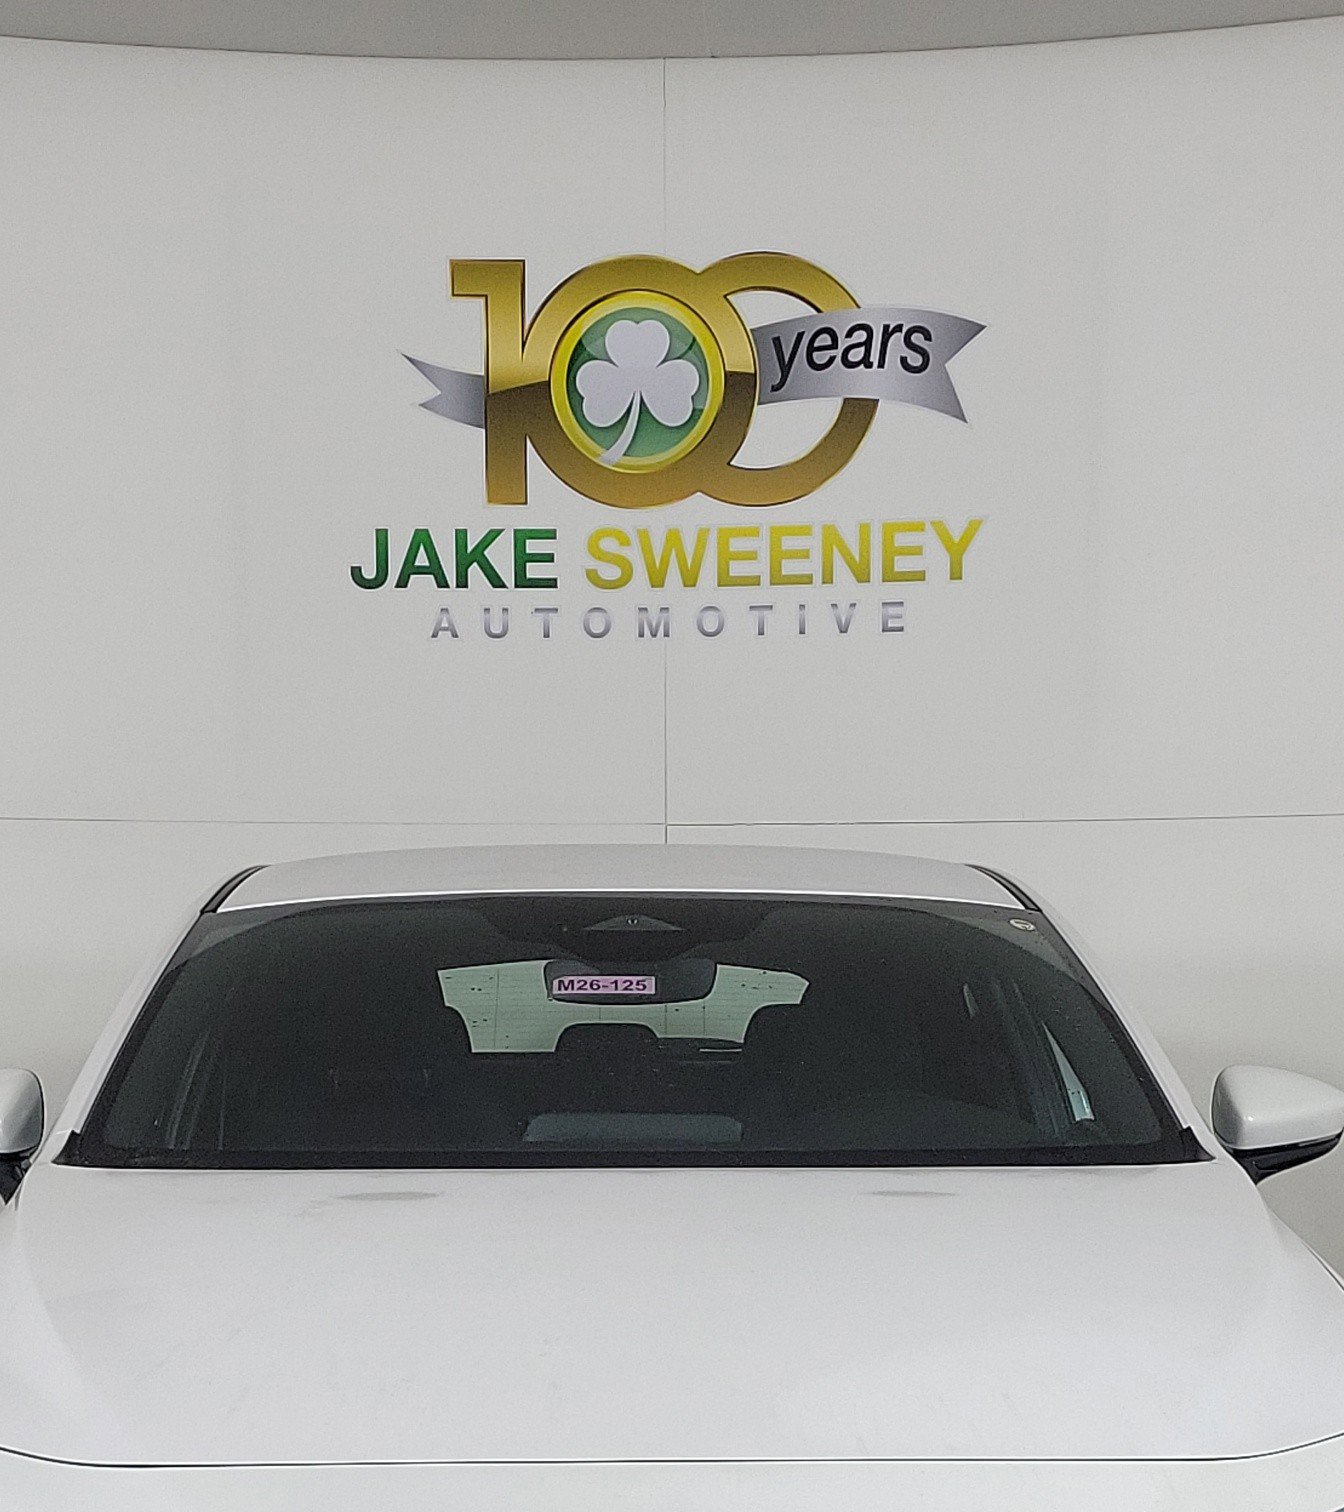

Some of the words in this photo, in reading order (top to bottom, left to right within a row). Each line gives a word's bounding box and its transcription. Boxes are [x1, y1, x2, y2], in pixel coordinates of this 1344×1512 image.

[449, 252, 879, 509] 100
[770, 321, 933, 393] years
[350, 527, 558, 590] JAKE
[585, 519, 983, 590] SWEENEY
[430, 601, 906, 640] AUTOMOTIVE
[557, 979, 647, 992] M26-125
